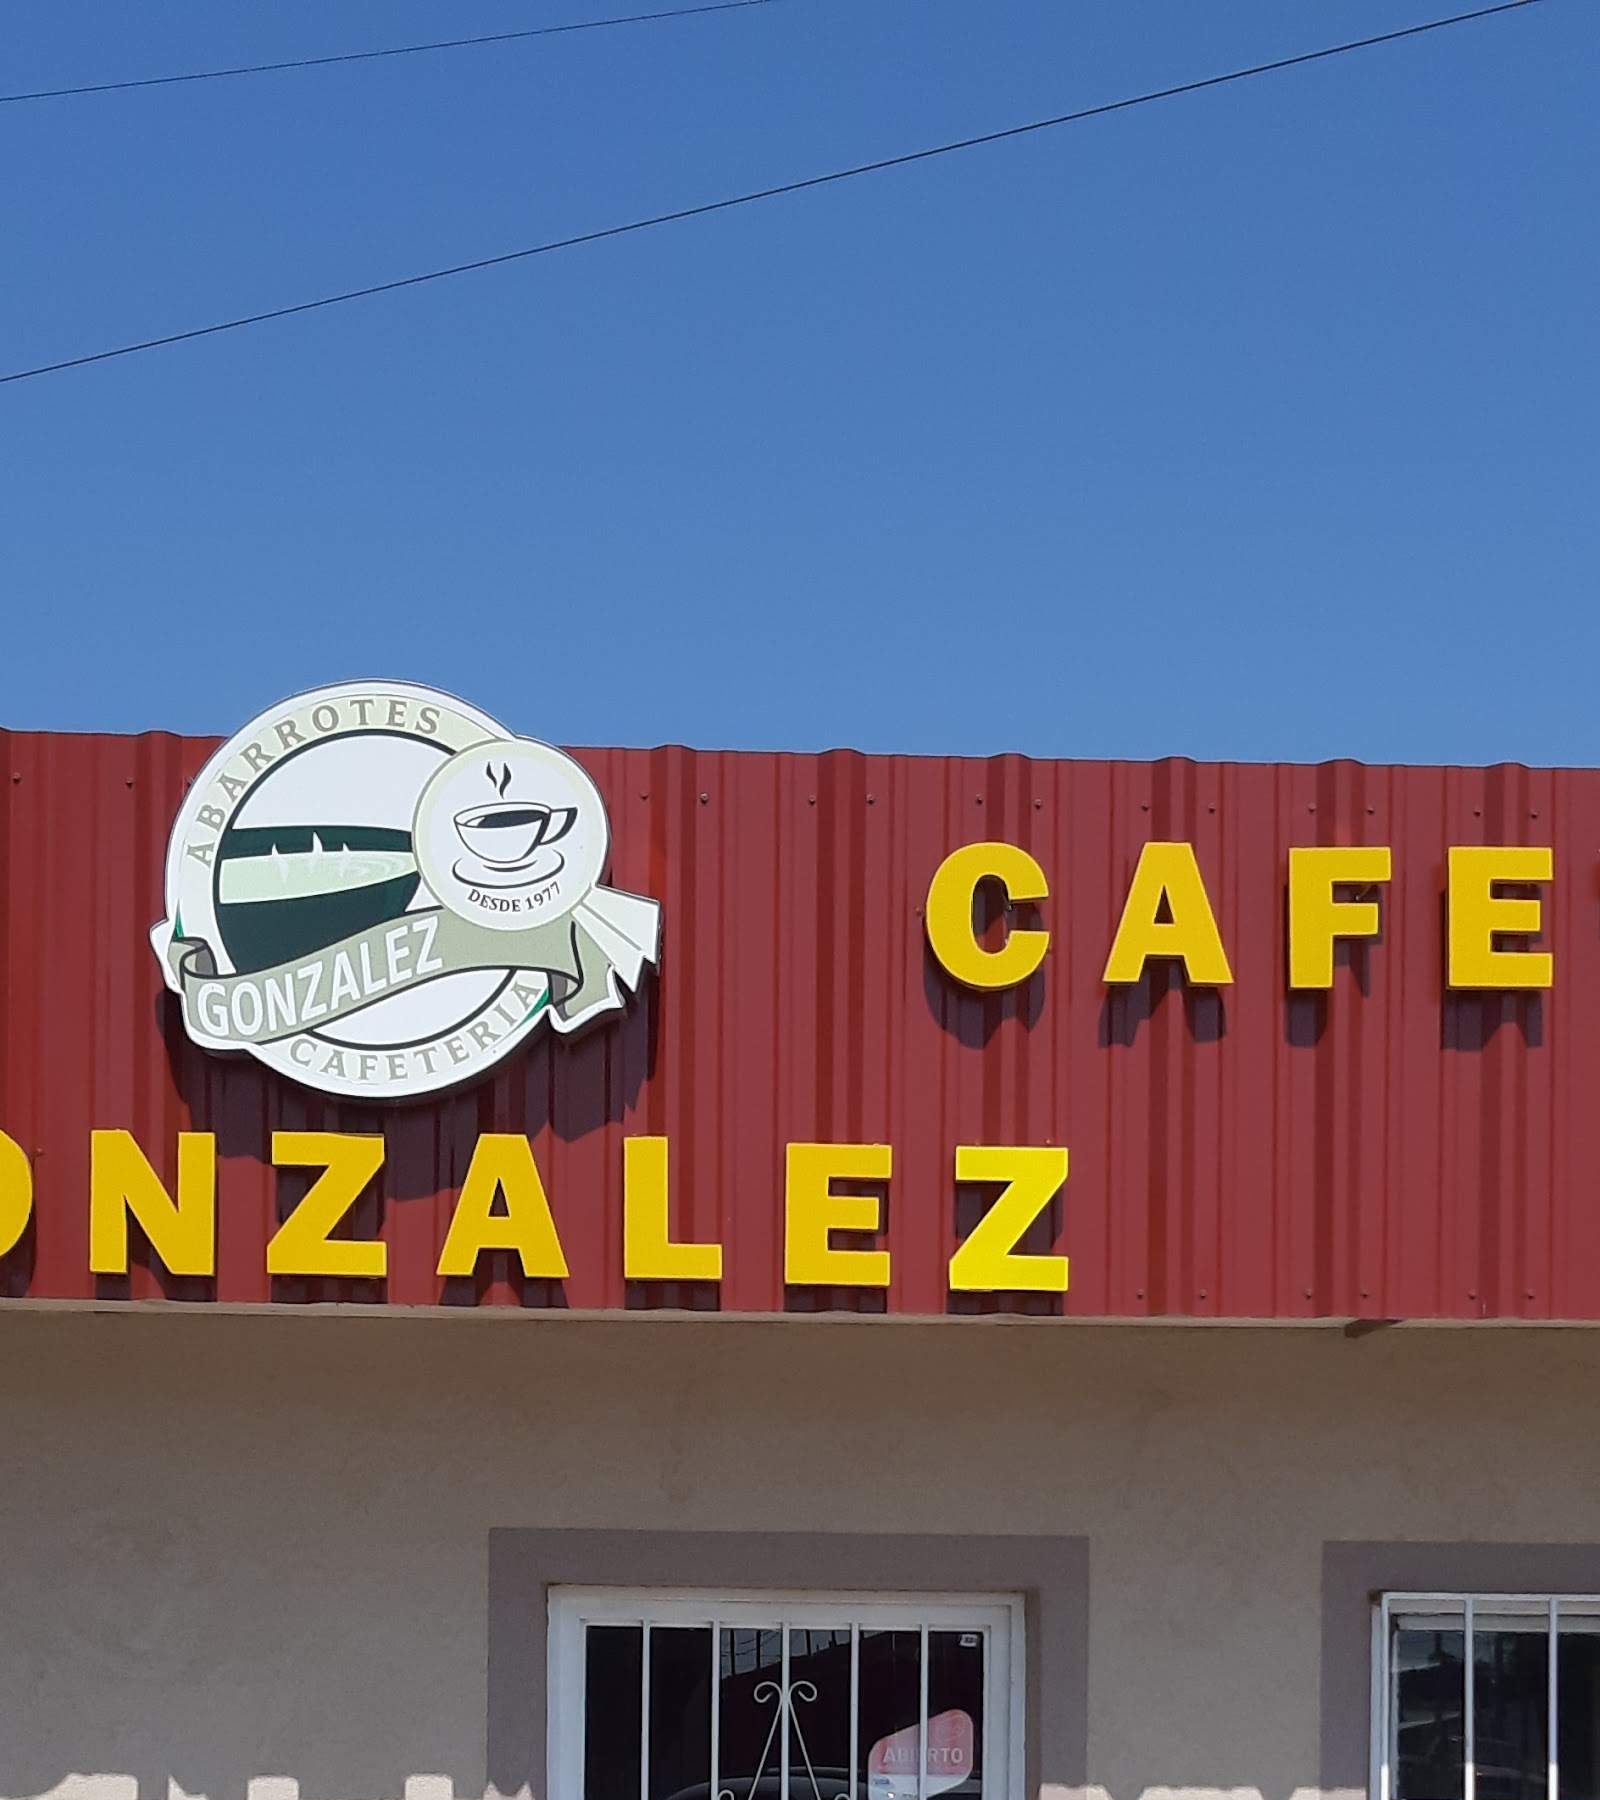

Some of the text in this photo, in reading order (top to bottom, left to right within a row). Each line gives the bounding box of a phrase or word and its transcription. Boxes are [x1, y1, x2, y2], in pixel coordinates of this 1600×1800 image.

[186, 699, 441, 868] ABARROTES
[467, 881, 560, 912] DESDE 1977
[197, 915, 444, 1036] GONZALEZ
[290, 979, 542, 1081] CAFETERIA
[882, 1746, 964, 1764] ABIRTO
